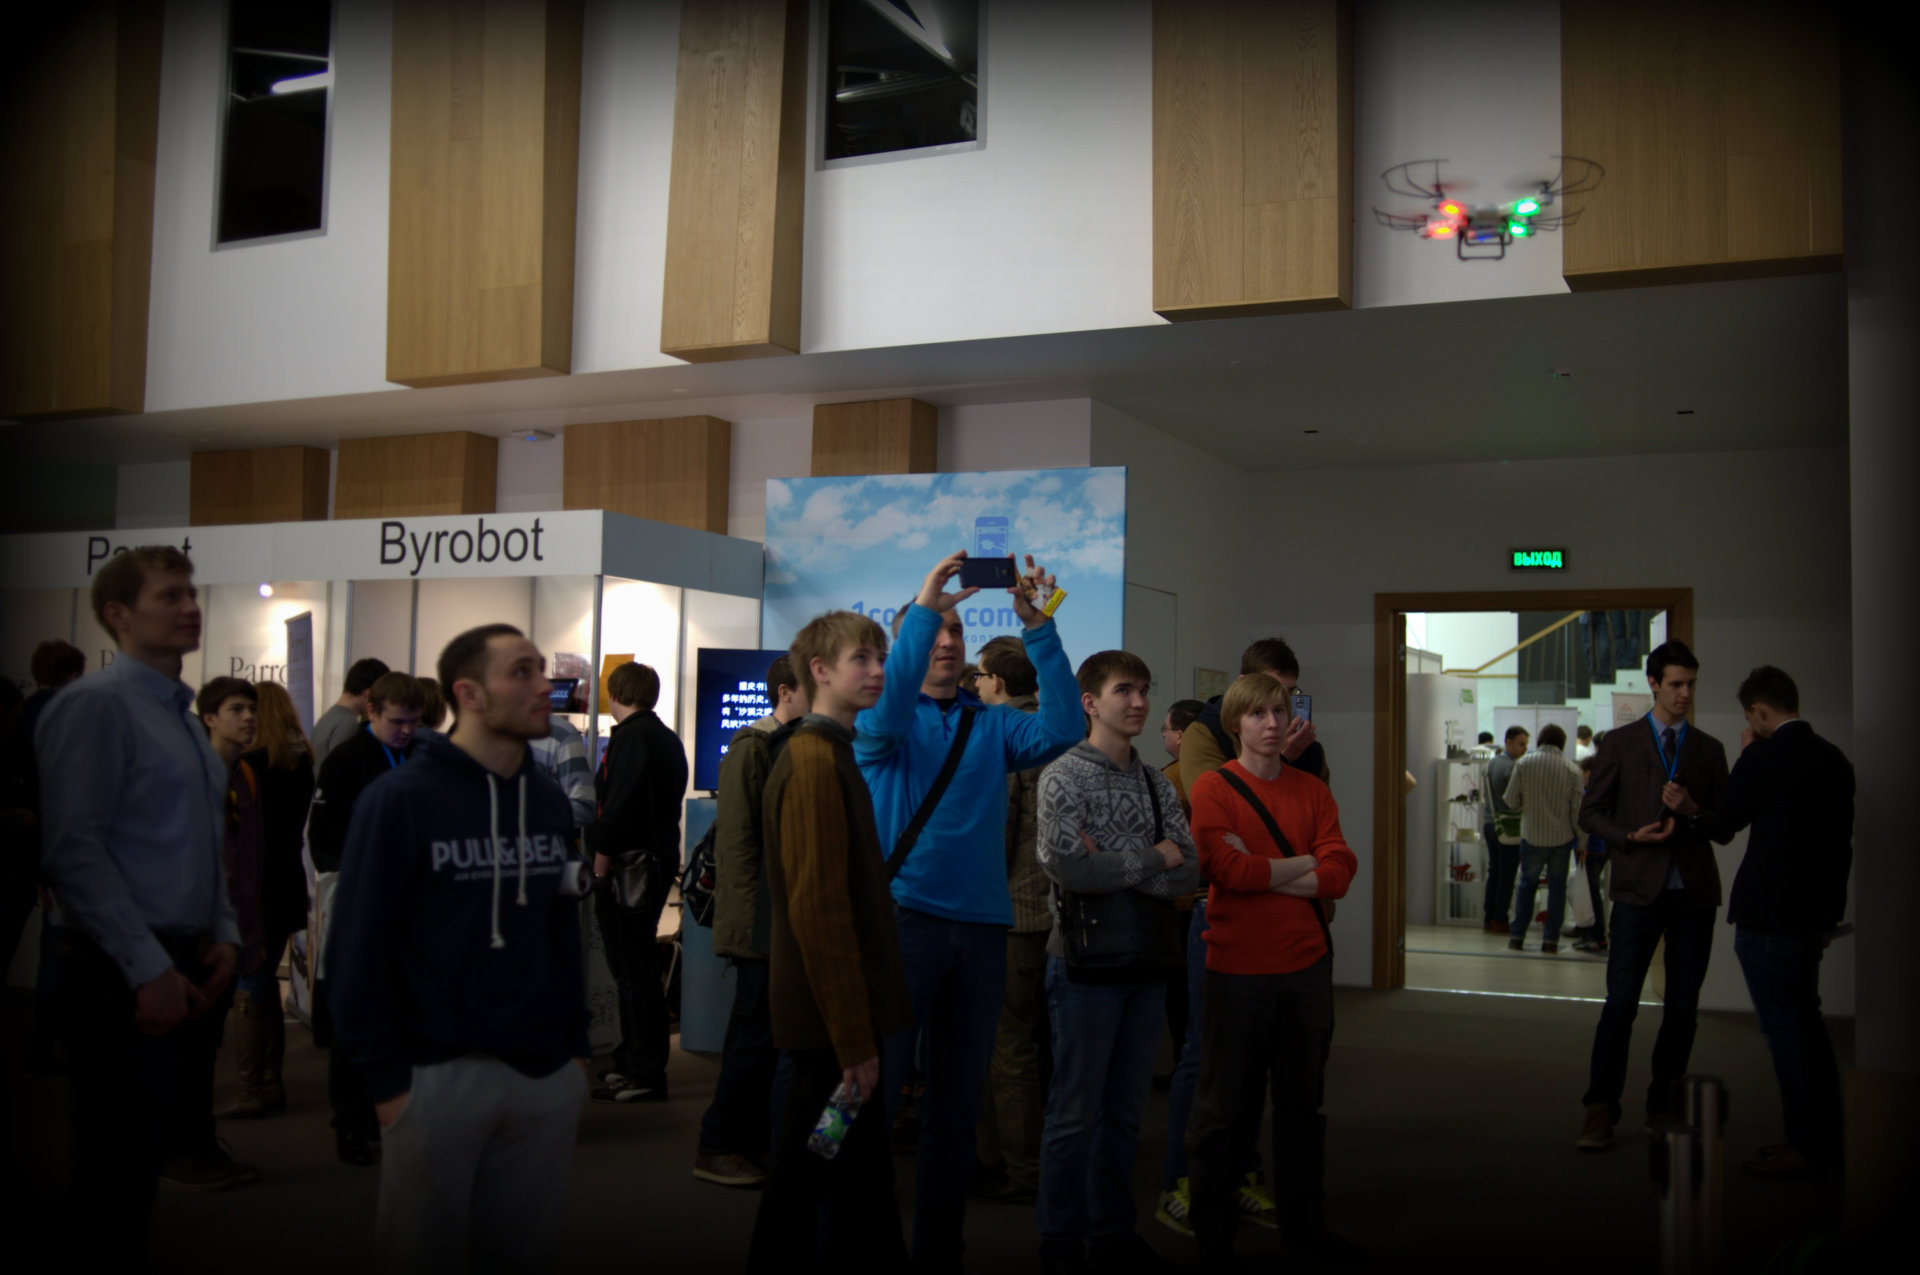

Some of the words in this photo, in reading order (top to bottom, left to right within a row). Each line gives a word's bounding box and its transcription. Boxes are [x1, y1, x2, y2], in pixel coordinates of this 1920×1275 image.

[380, 518, 544, 576] Byrobot
[1514, 551, 1562, 568] ВЫХОД
[431, 834, 567, 872] PULL&BEA
